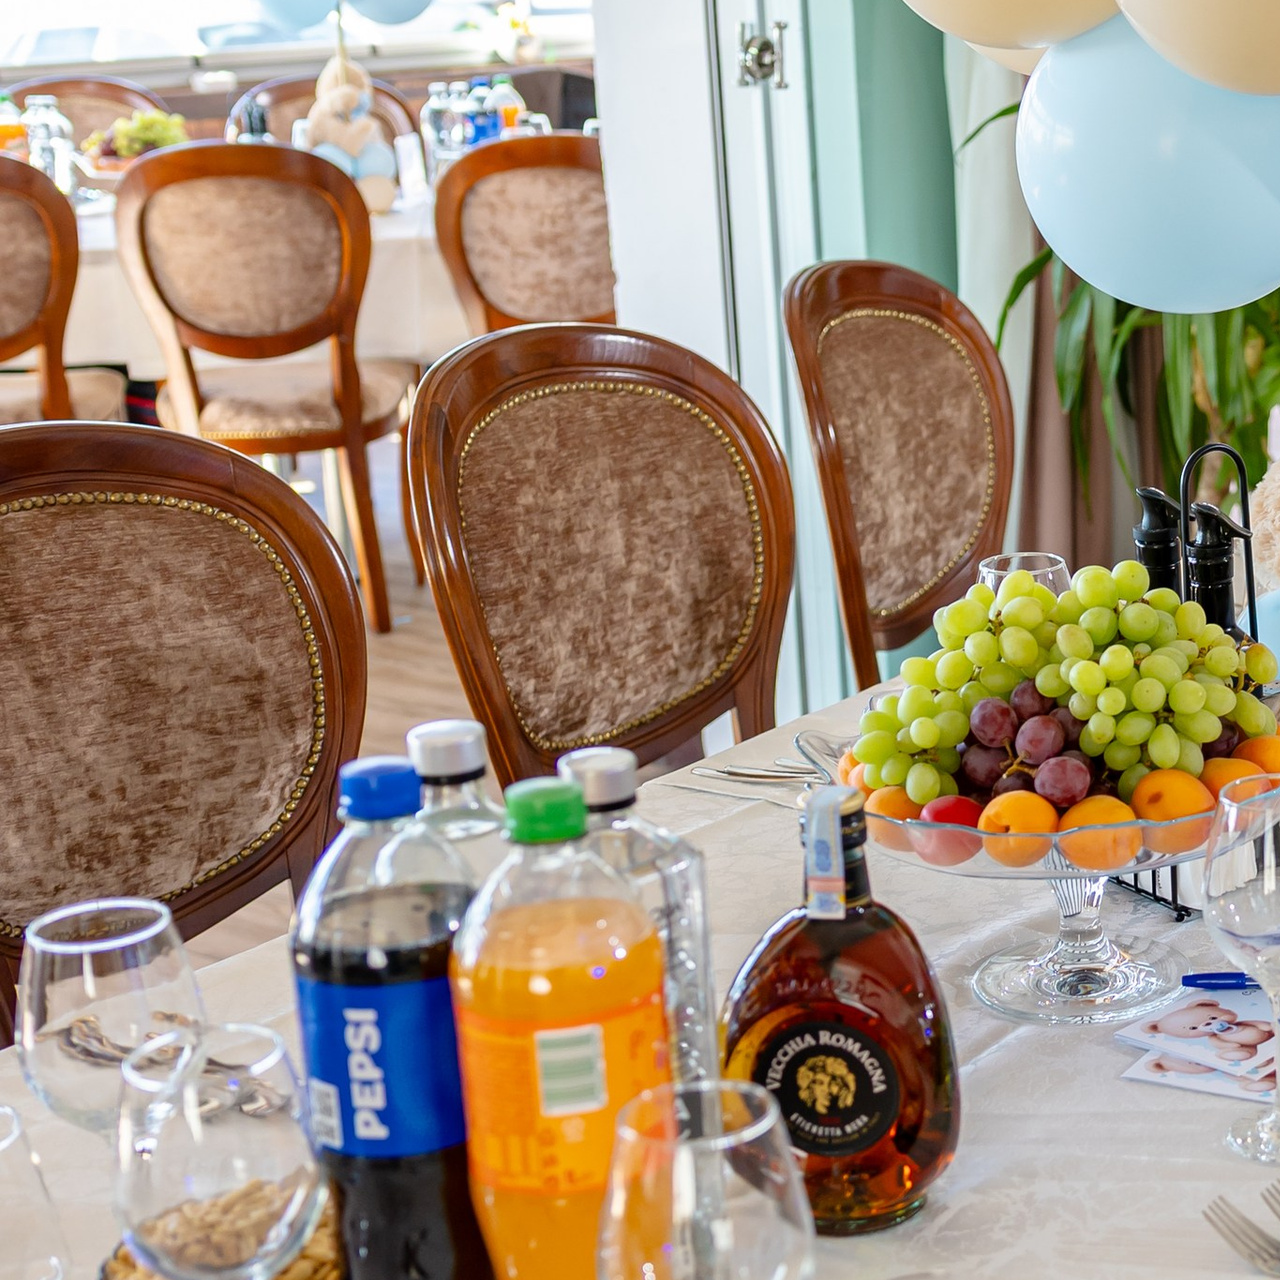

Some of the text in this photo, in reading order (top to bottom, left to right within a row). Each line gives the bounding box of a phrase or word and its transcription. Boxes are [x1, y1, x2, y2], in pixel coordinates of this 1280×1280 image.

[343, 1008, 390, 1140] PEPSI
[765, 1030, 888, 1094] VECCHIA ROMAGNA
